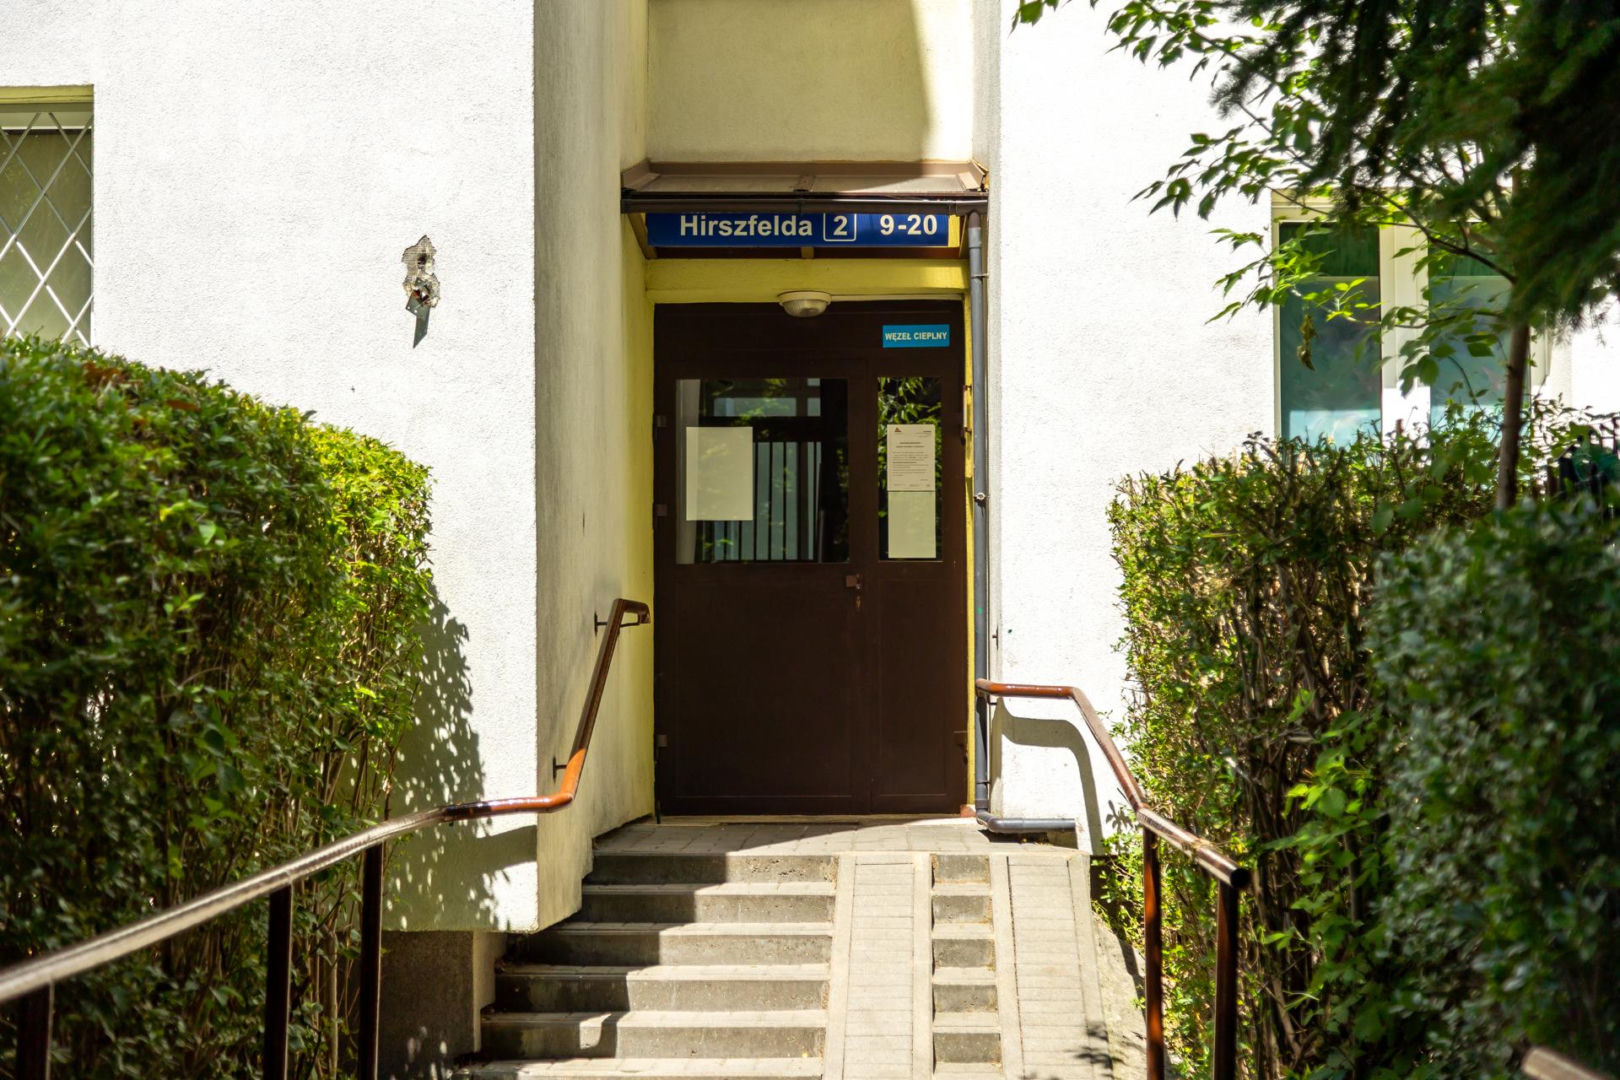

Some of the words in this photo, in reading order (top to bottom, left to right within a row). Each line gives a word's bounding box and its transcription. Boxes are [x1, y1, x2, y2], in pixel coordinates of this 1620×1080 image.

[680, 215, 813, 236] Hirszfelda
[833, 215, 848, 236] 2
[879, 214, 938, 236] 9-20
[885, 332, 911, 342] WĘZEŁ
[913, 331, 948, 340] CIEPLNY
